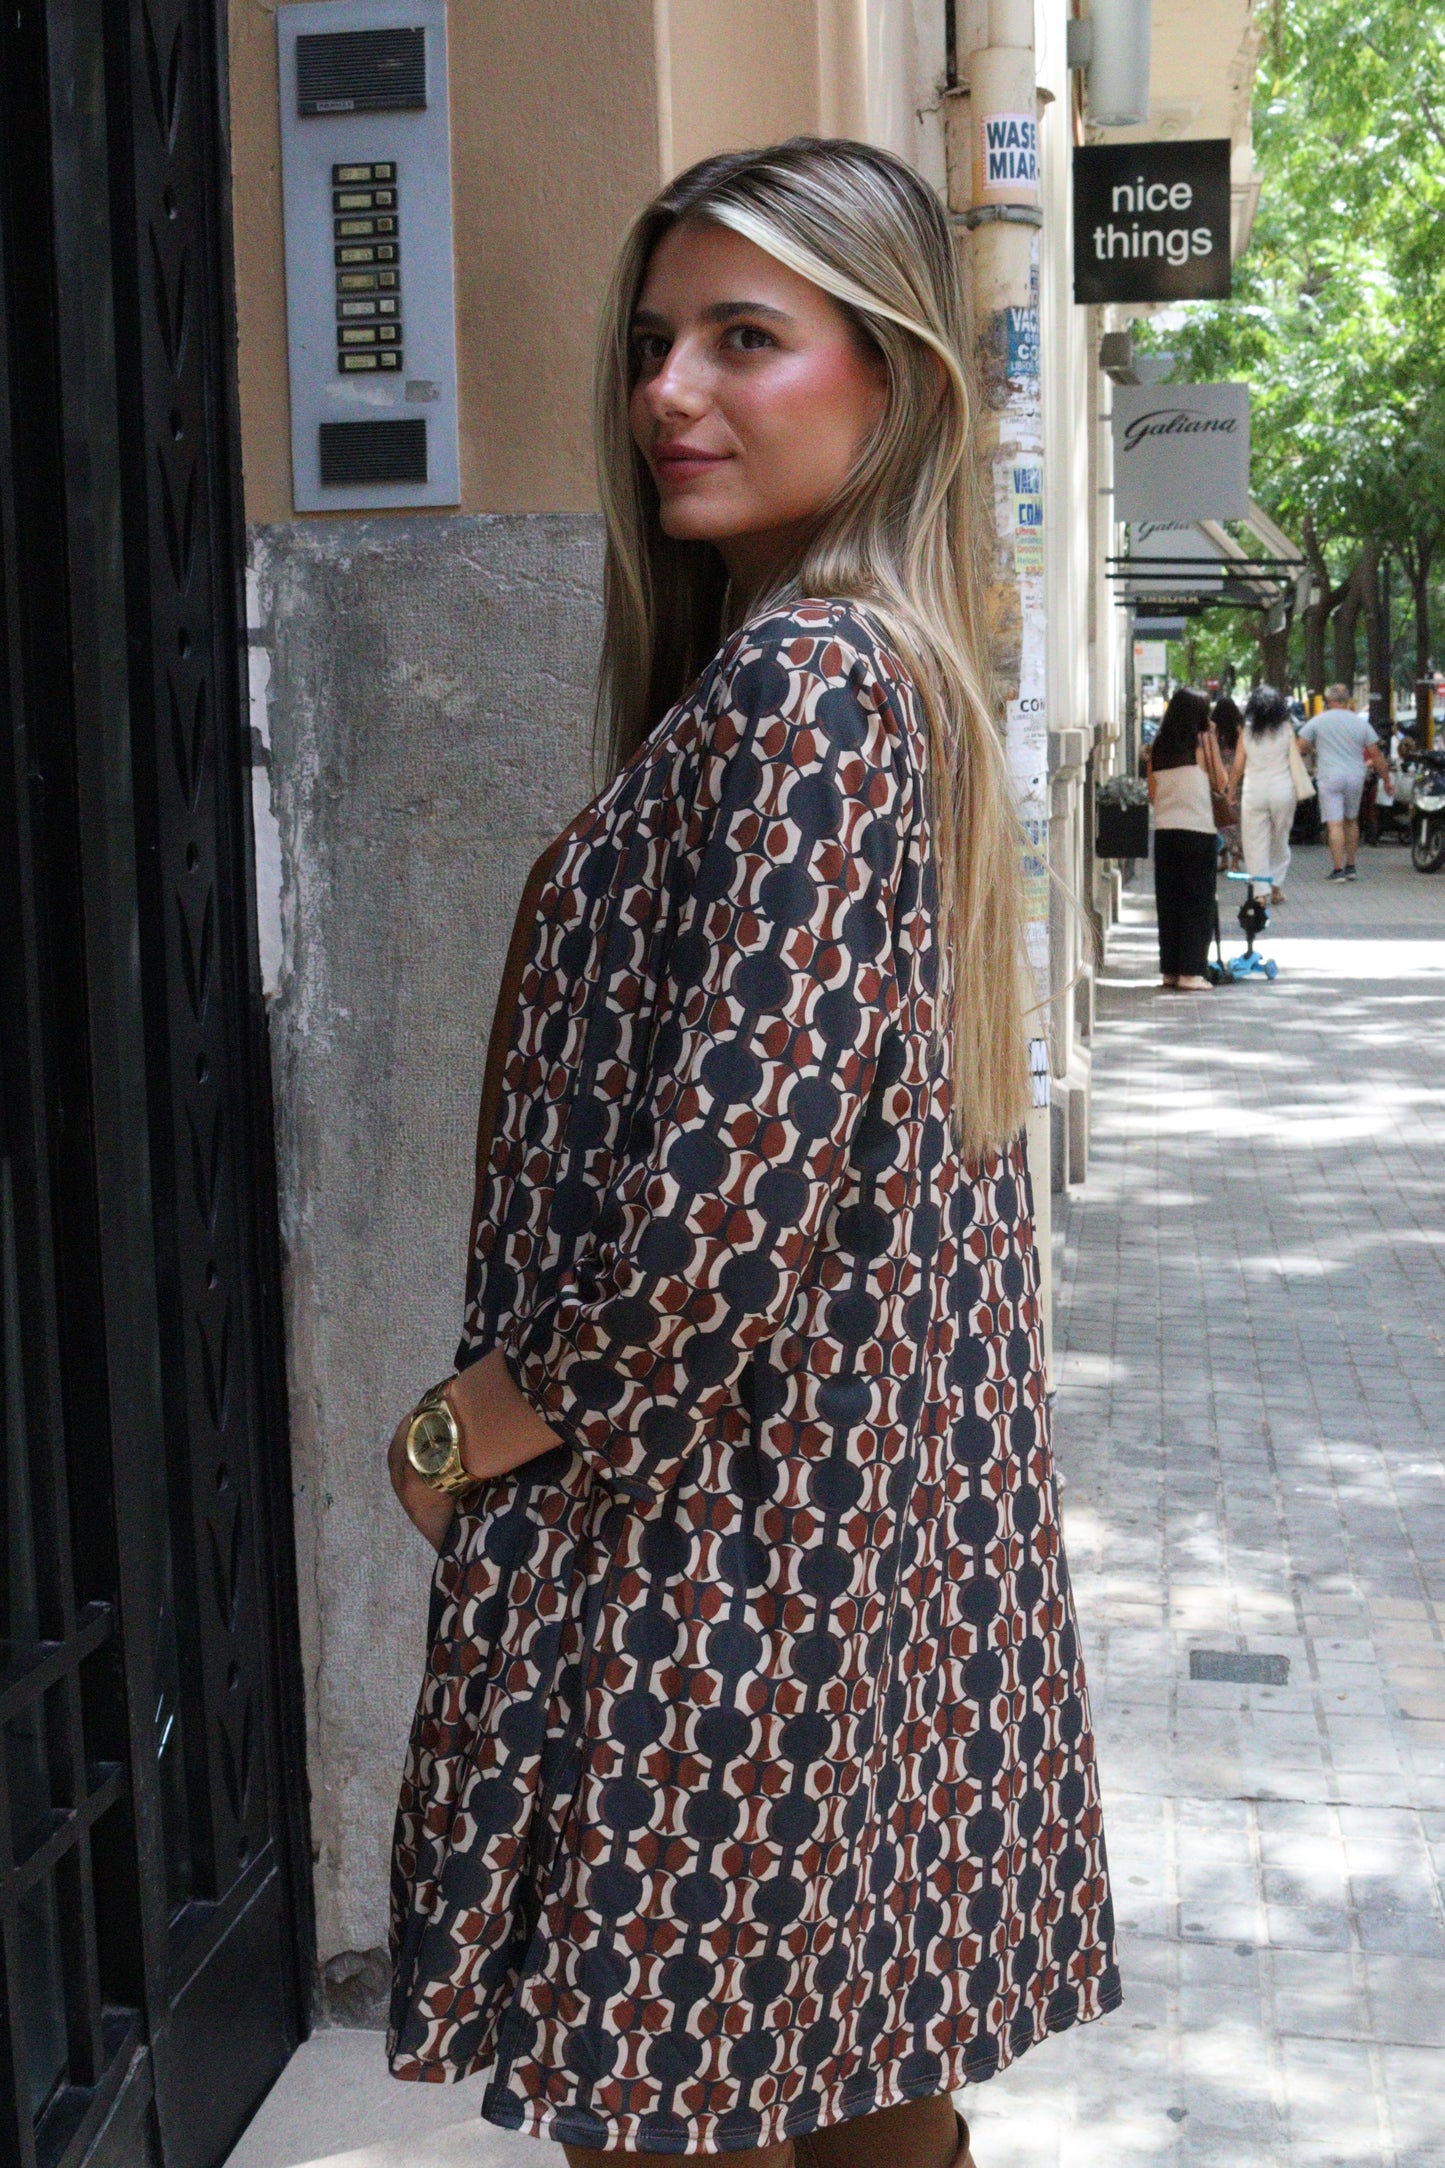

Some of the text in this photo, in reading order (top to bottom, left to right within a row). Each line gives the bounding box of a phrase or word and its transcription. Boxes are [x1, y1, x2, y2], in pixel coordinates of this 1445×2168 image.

[1112, 176, 1193, 213] nice
[1093, 222, 1213, 266] things
[1123, 408, 1238, 452] Galiana
